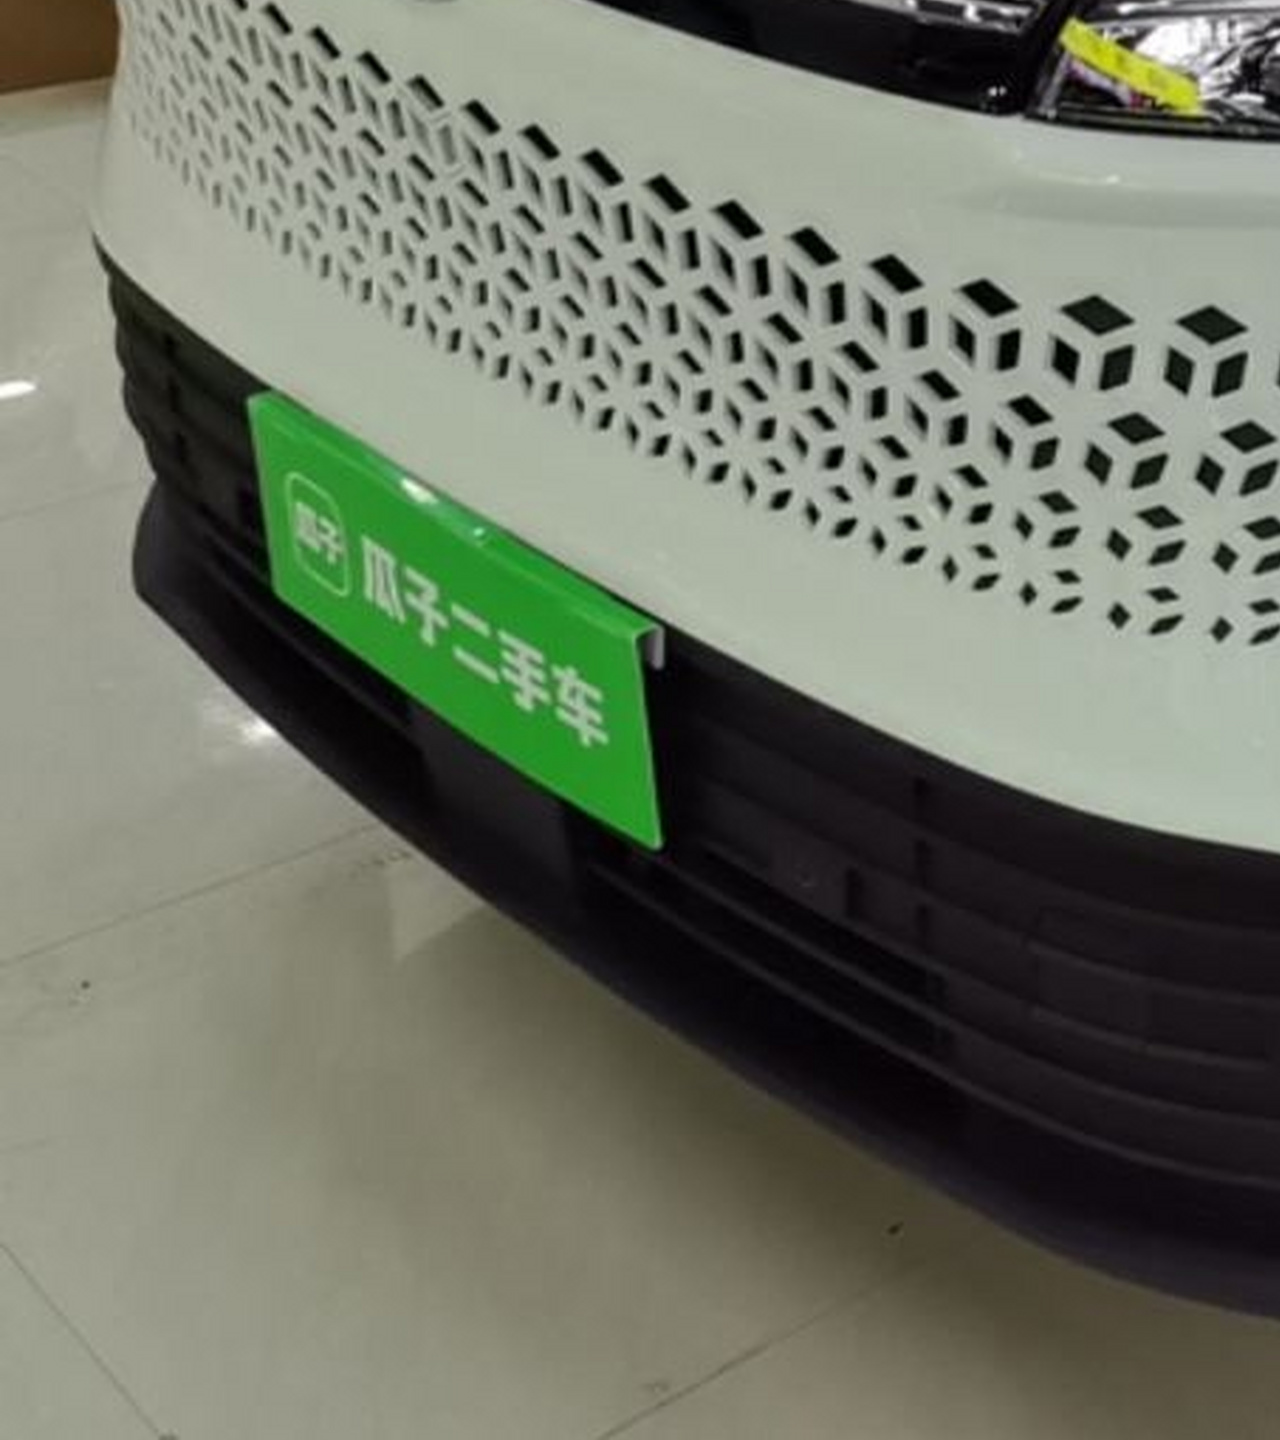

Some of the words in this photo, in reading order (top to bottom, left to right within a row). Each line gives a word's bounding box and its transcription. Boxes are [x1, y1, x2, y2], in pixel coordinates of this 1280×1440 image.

[294, 500, 343, 565] 瓜子
[359, 534, 609, 748] 瓜子二手车
